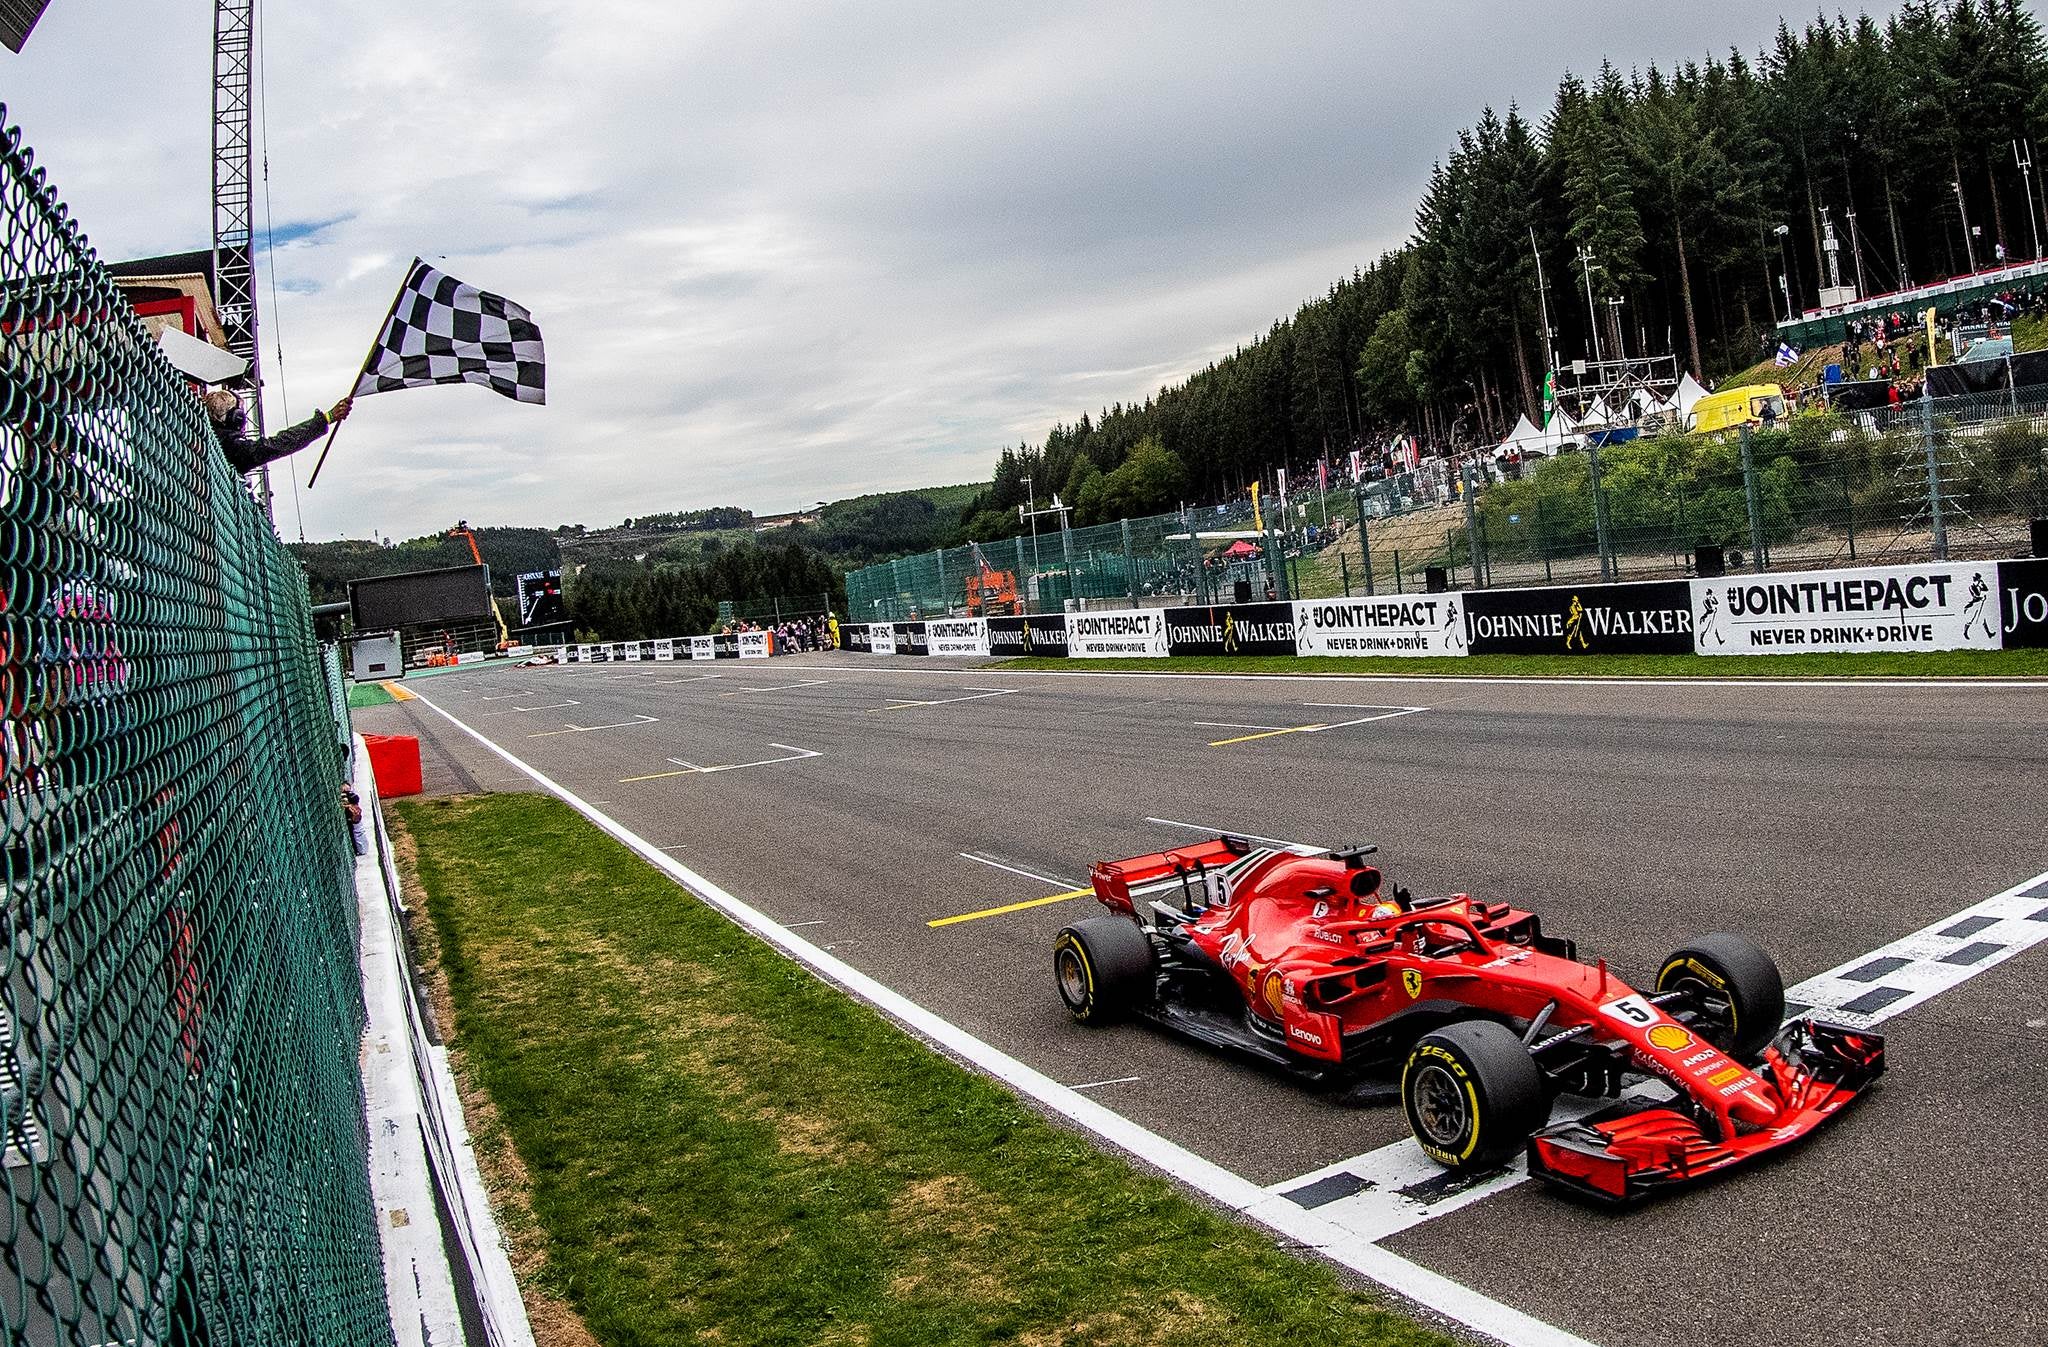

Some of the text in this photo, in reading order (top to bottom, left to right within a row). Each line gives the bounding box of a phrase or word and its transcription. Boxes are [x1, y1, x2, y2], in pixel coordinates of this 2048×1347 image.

[1727, 575, 1952, 617] #JOINTHEPACT
[1313, 601, 1437, 629] #JOINTHEPACT
[1467, 606, 1692, 645] JOHNNIE WALKER
[989, 627, 1068, 649] JOHNNIE WALKER
[1167, 620, 1295, 649] JOHNNIE WALKER
[1326, 637, 1359, 651] NEVER
[1750, 628, 1805, 647] NEVER
[1086, 643, 1105, 653] NEVER
[1216, 877, 1226, 905] 5
[1615, 1001, 1650, 1023] 5
[1290, 1024, 1322, 1045] Lenovo
[1530, 1026, 1583, 1050] Lenovo
[1420, 1045, 1468, 1077] ZERO
[1682, 1052, 1708, 1067] AMD
[1719, 1076, 1757, 1097] MAHLE
